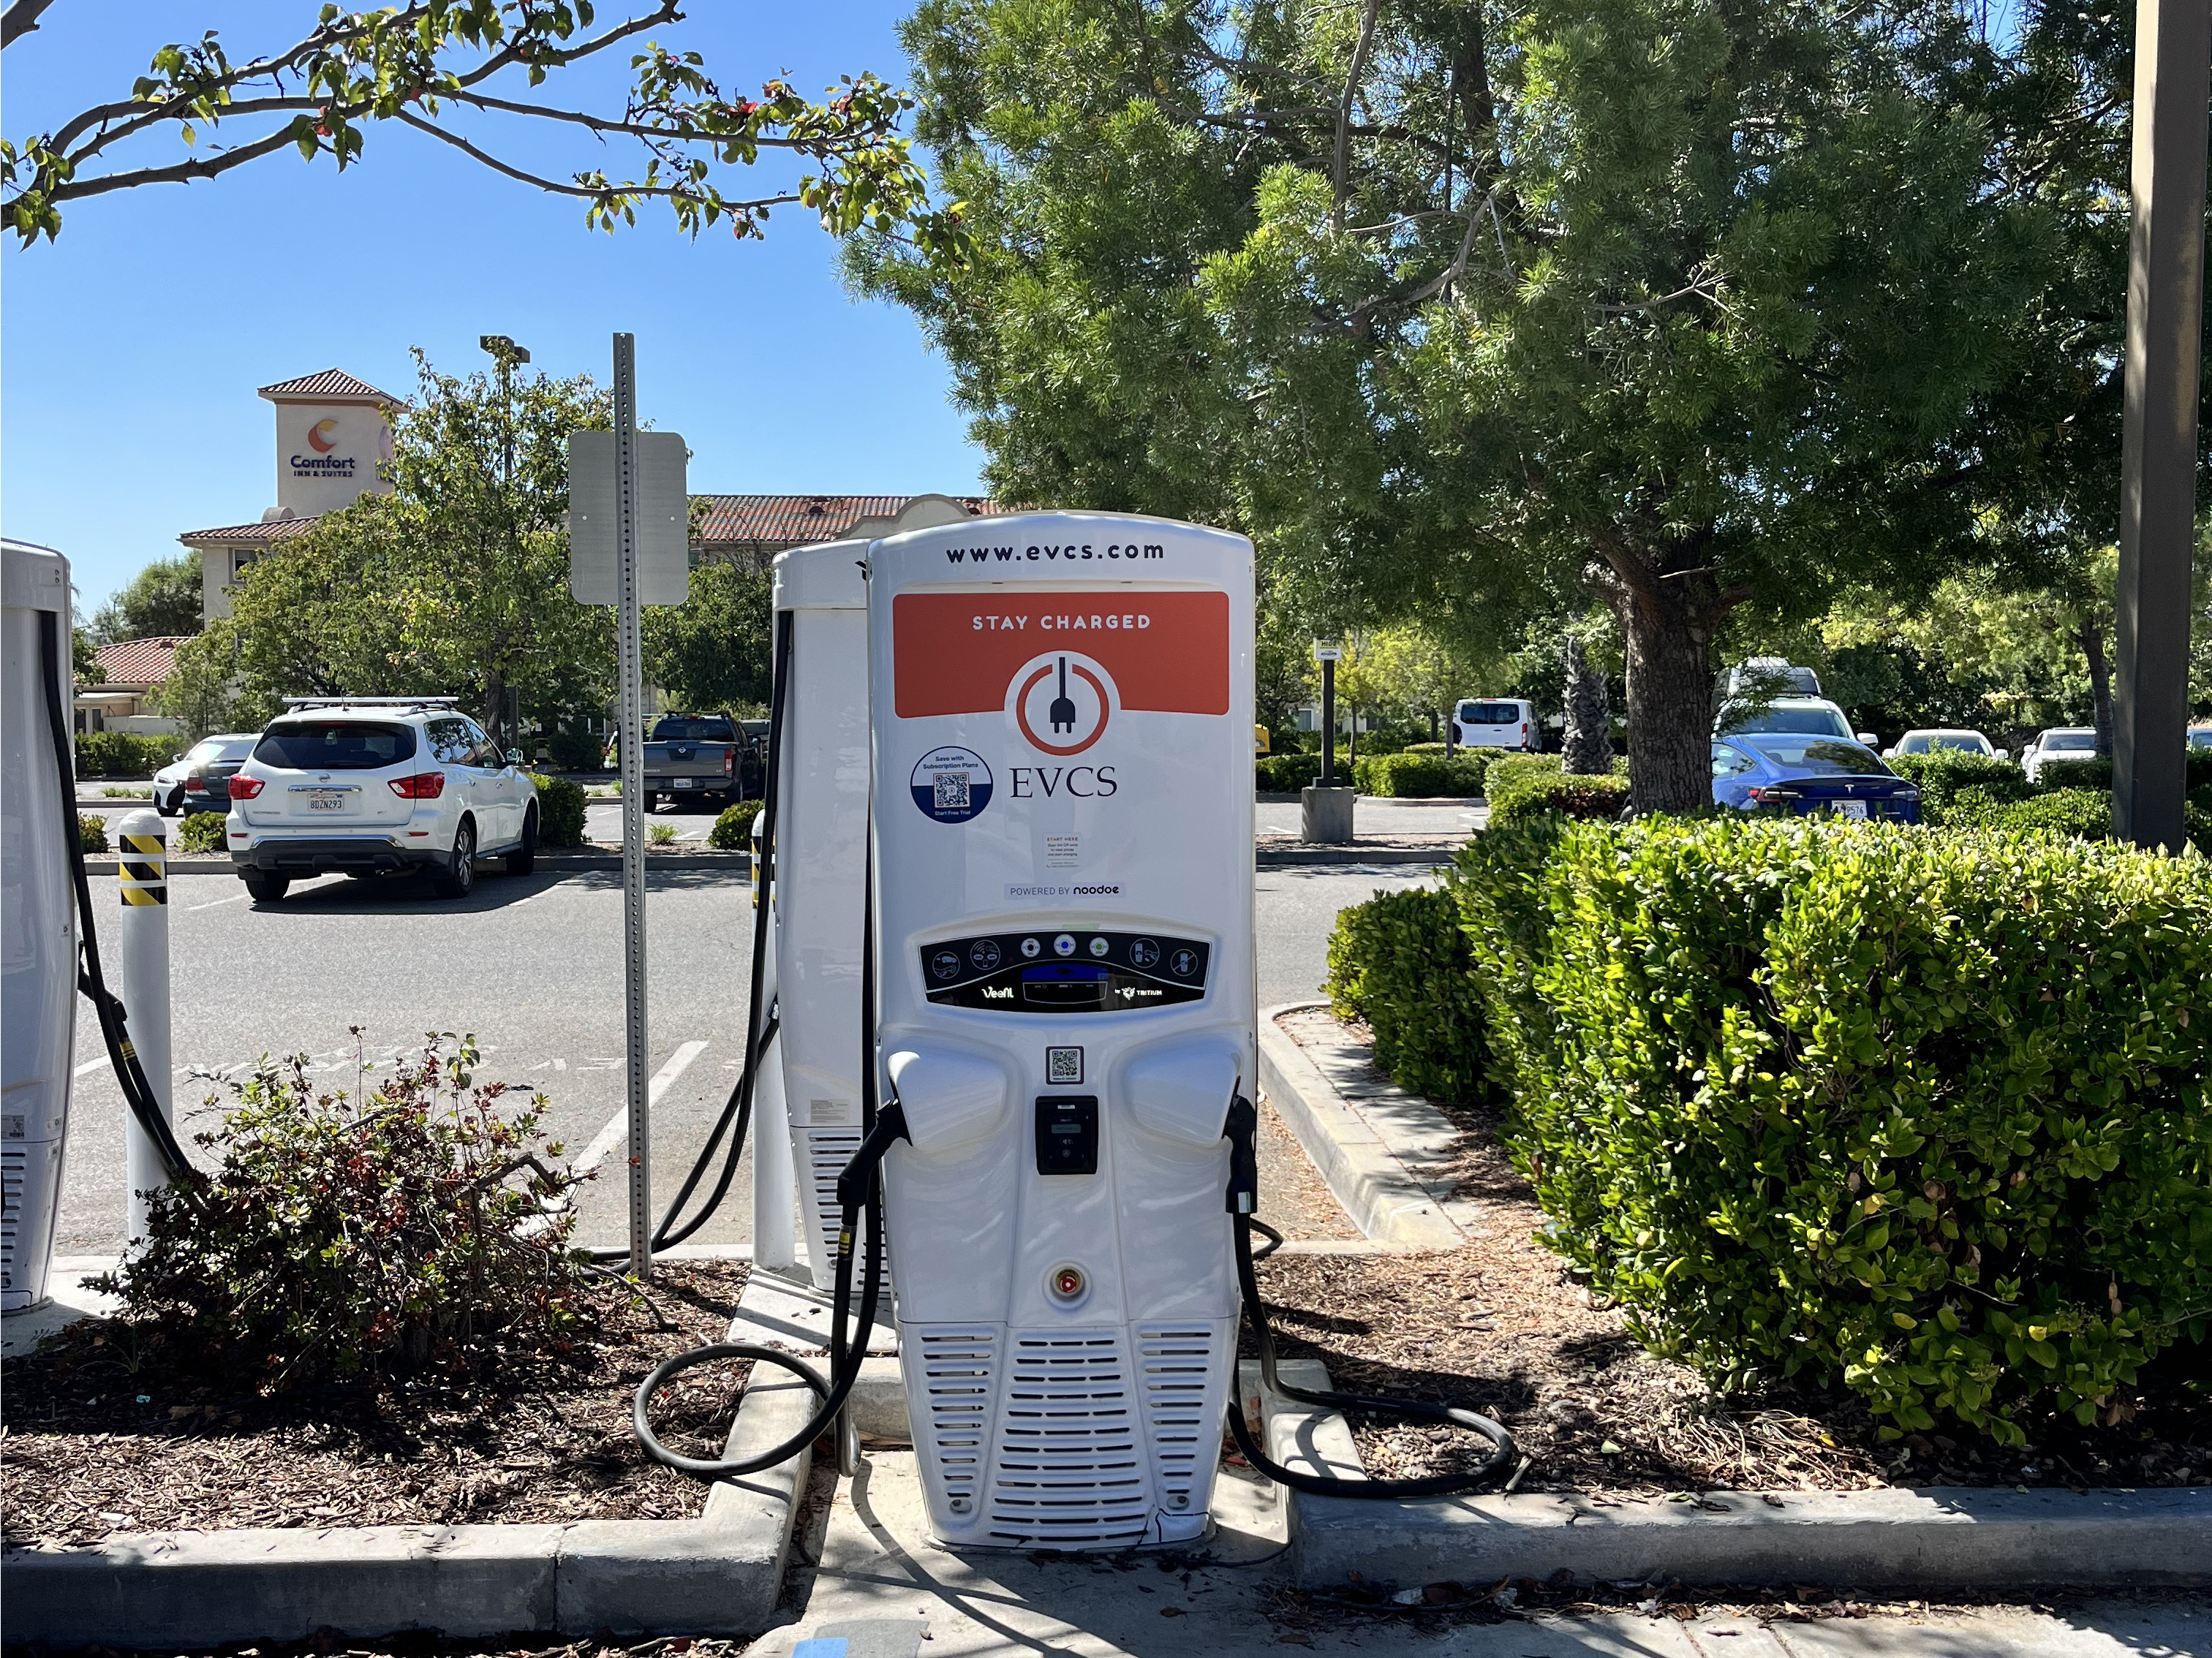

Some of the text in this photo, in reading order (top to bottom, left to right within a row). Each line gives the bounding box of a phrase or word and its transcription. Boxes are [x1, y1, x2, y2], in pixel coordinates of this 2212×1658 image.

[290, 455, 355, 469] Comfort
[946, 545, 1164, 564] www.evcs.com
[973, 615, 1150, 630] STAY CHARGED
[1009, 766, 1117, 798] EVCS
[310, 800, 342, 809] 8DZN293
[1010, 885, 1120, 896] POWERED BY noodoe
